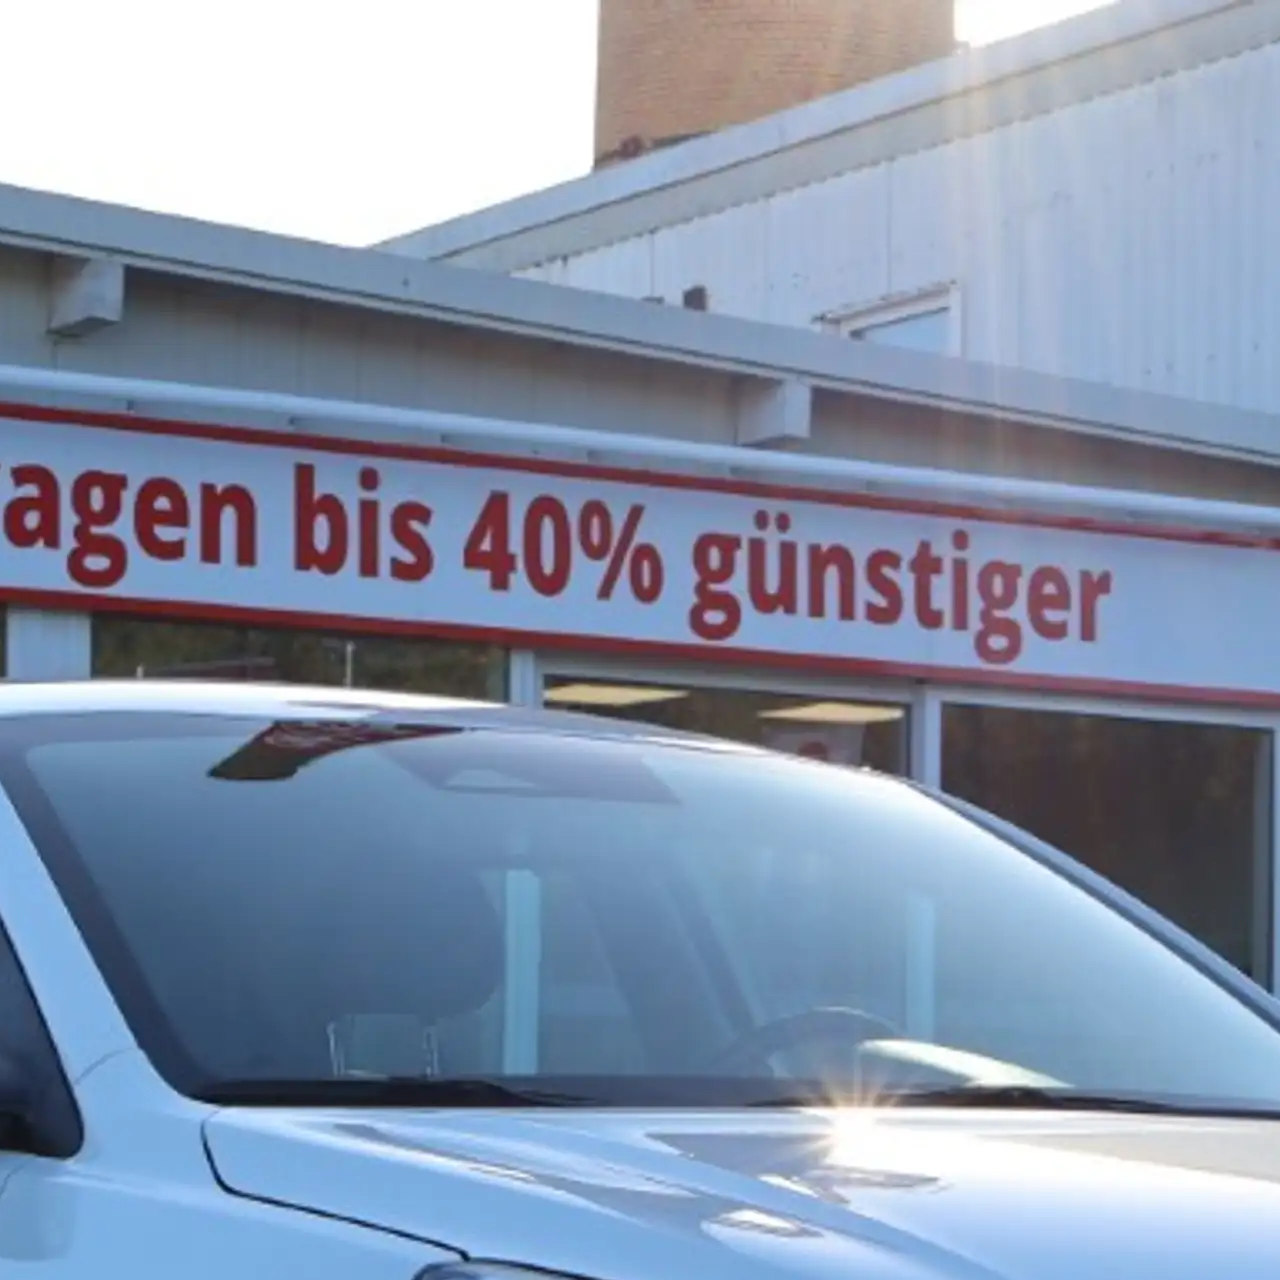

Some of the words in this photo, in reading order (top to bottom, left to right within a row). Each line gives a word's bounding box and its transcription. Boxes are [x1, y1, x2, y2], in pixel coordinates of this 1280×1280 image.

[293, 463, 434, 582] bis
[462, 488, 665, 603] 40%
[691, 510, 1113, 665] günstiger
